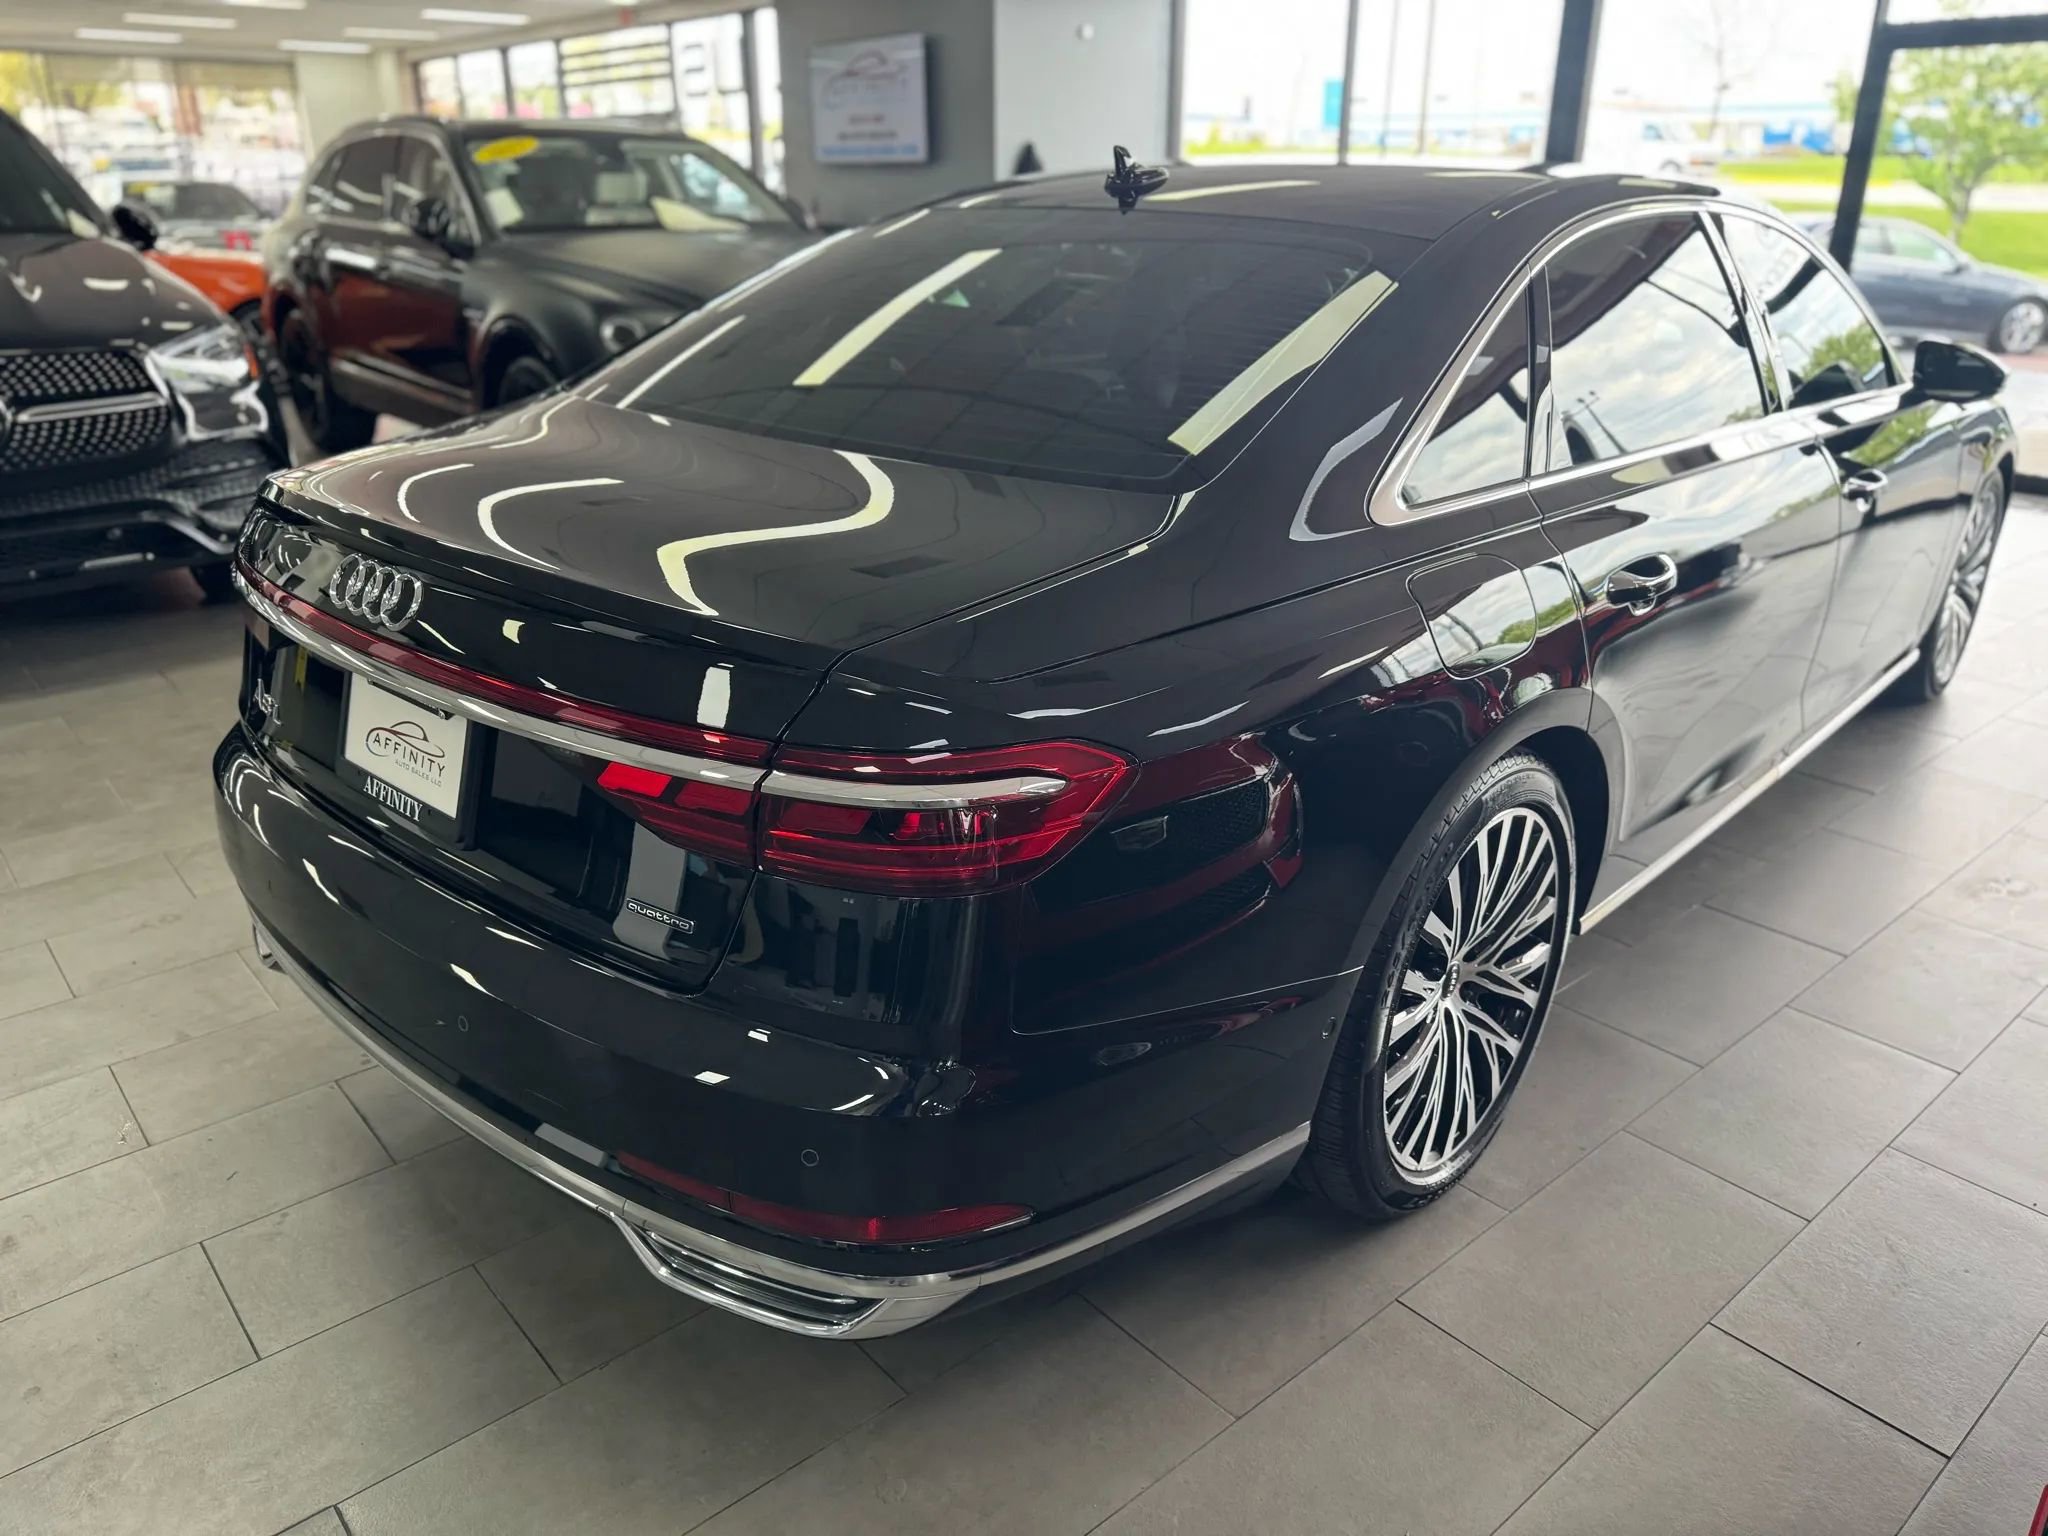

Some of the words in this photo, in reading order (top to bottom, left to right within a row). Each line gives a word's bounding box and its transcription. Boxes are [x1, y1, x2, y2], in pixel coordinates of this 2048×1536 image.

[372, 732, 446, 778] AFFINITY
[394, 759, 410, 770] AUTO
[411, 766, 430, 781] SALES
[363, 775, 423, 822] AFFINITY
[628, 902, 690, 930] quattro
